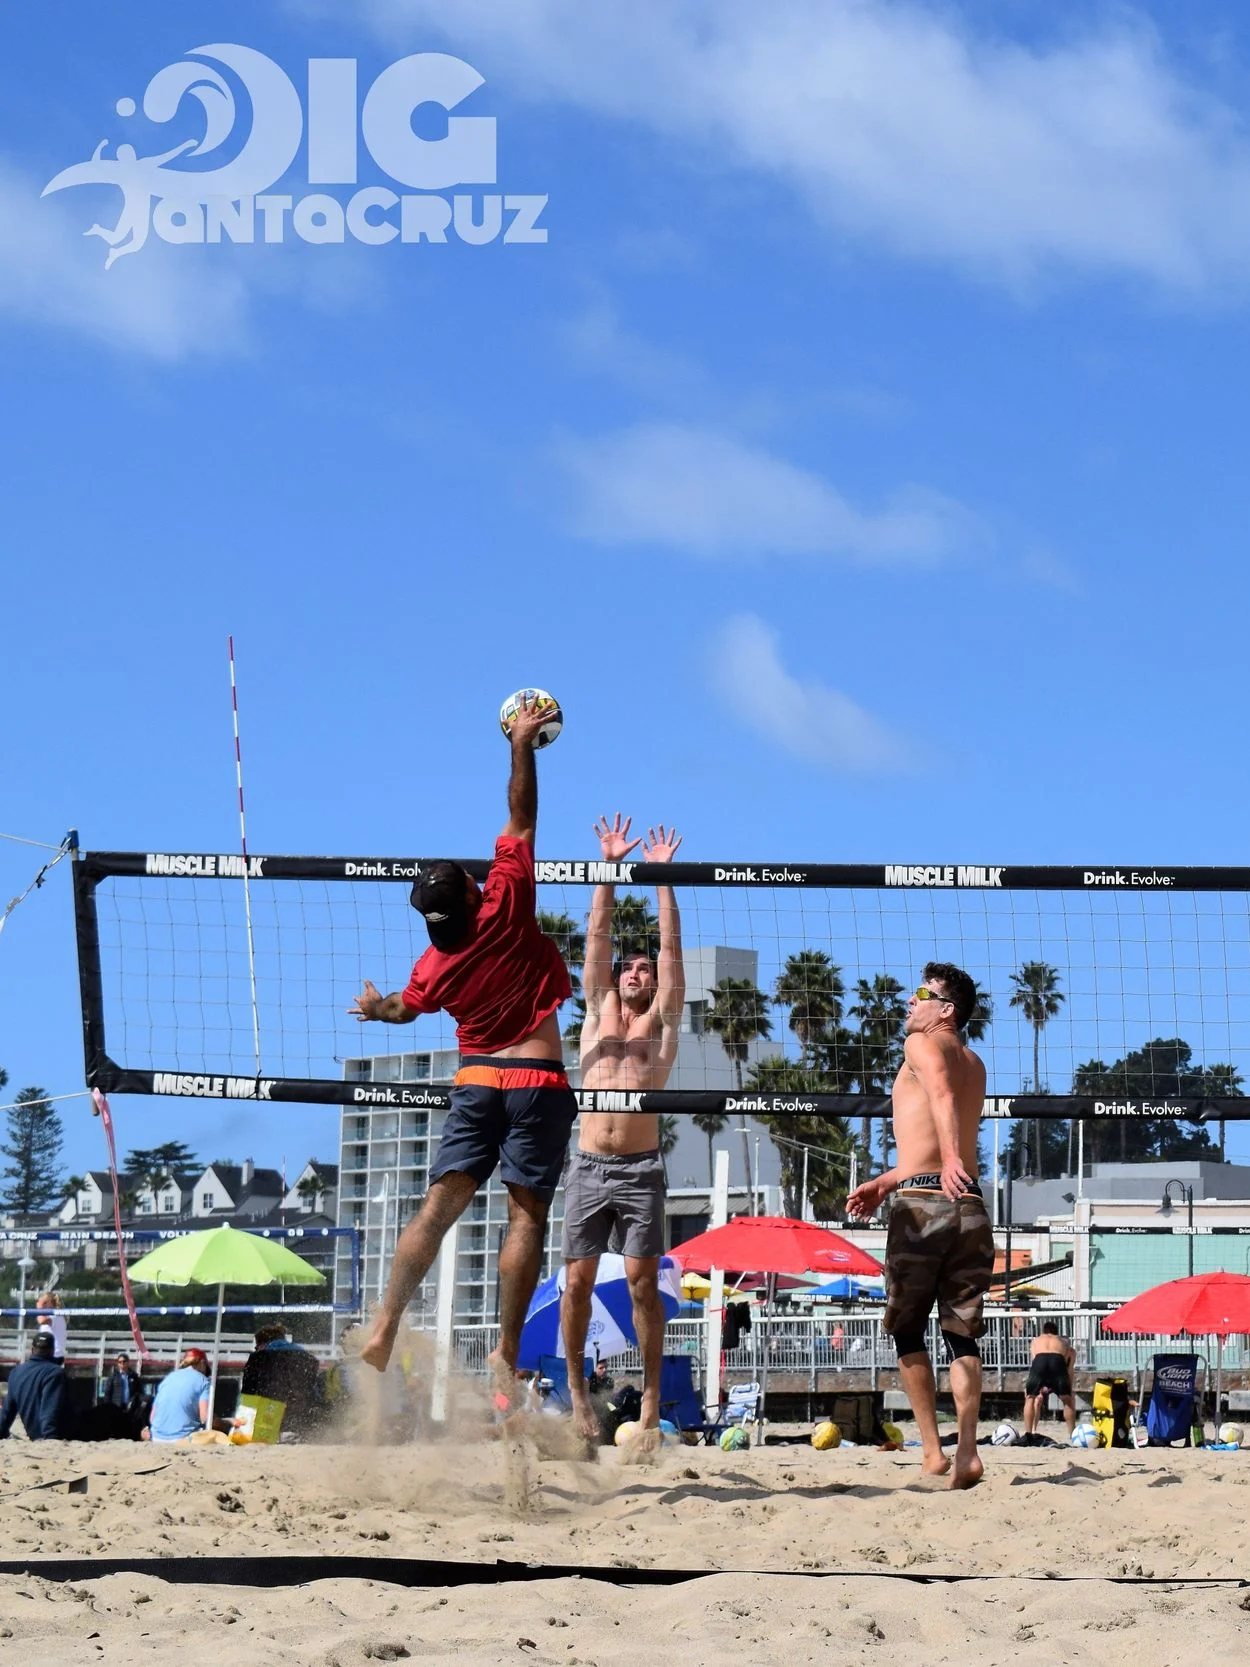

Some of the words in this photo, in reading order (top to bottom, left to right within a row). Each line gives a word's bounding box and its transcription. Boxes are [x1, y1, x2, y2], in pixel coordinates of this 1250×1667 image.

[146, 853, 215, 875] MUSCLE
[219, 855, 263, 876] MILK
[346, 862, 390, 875] Drink.
[535, 862, 584, 881] USCLE
[588, 861, 632, 882] MILK
[715, 867, 759, 880] Drink.
[885, 865, 954, 885] MUSCLE
[958, 865, 1001, 886] MILK
[1084, 871, 1128, 884] Drink.
[154, 1073, 224, 1096] MUSCLE
[355, 1087, 399, 1102] Drink.
[597, 1091, 642, 1110] MILK
[726, 1096, 770, 1110] Drink.
[981, 1098, 1011, 1116] ILK
[1095, 1101, 1139, 1114] Drink.
[1159, 1381, 1190, 1389] BEACH
